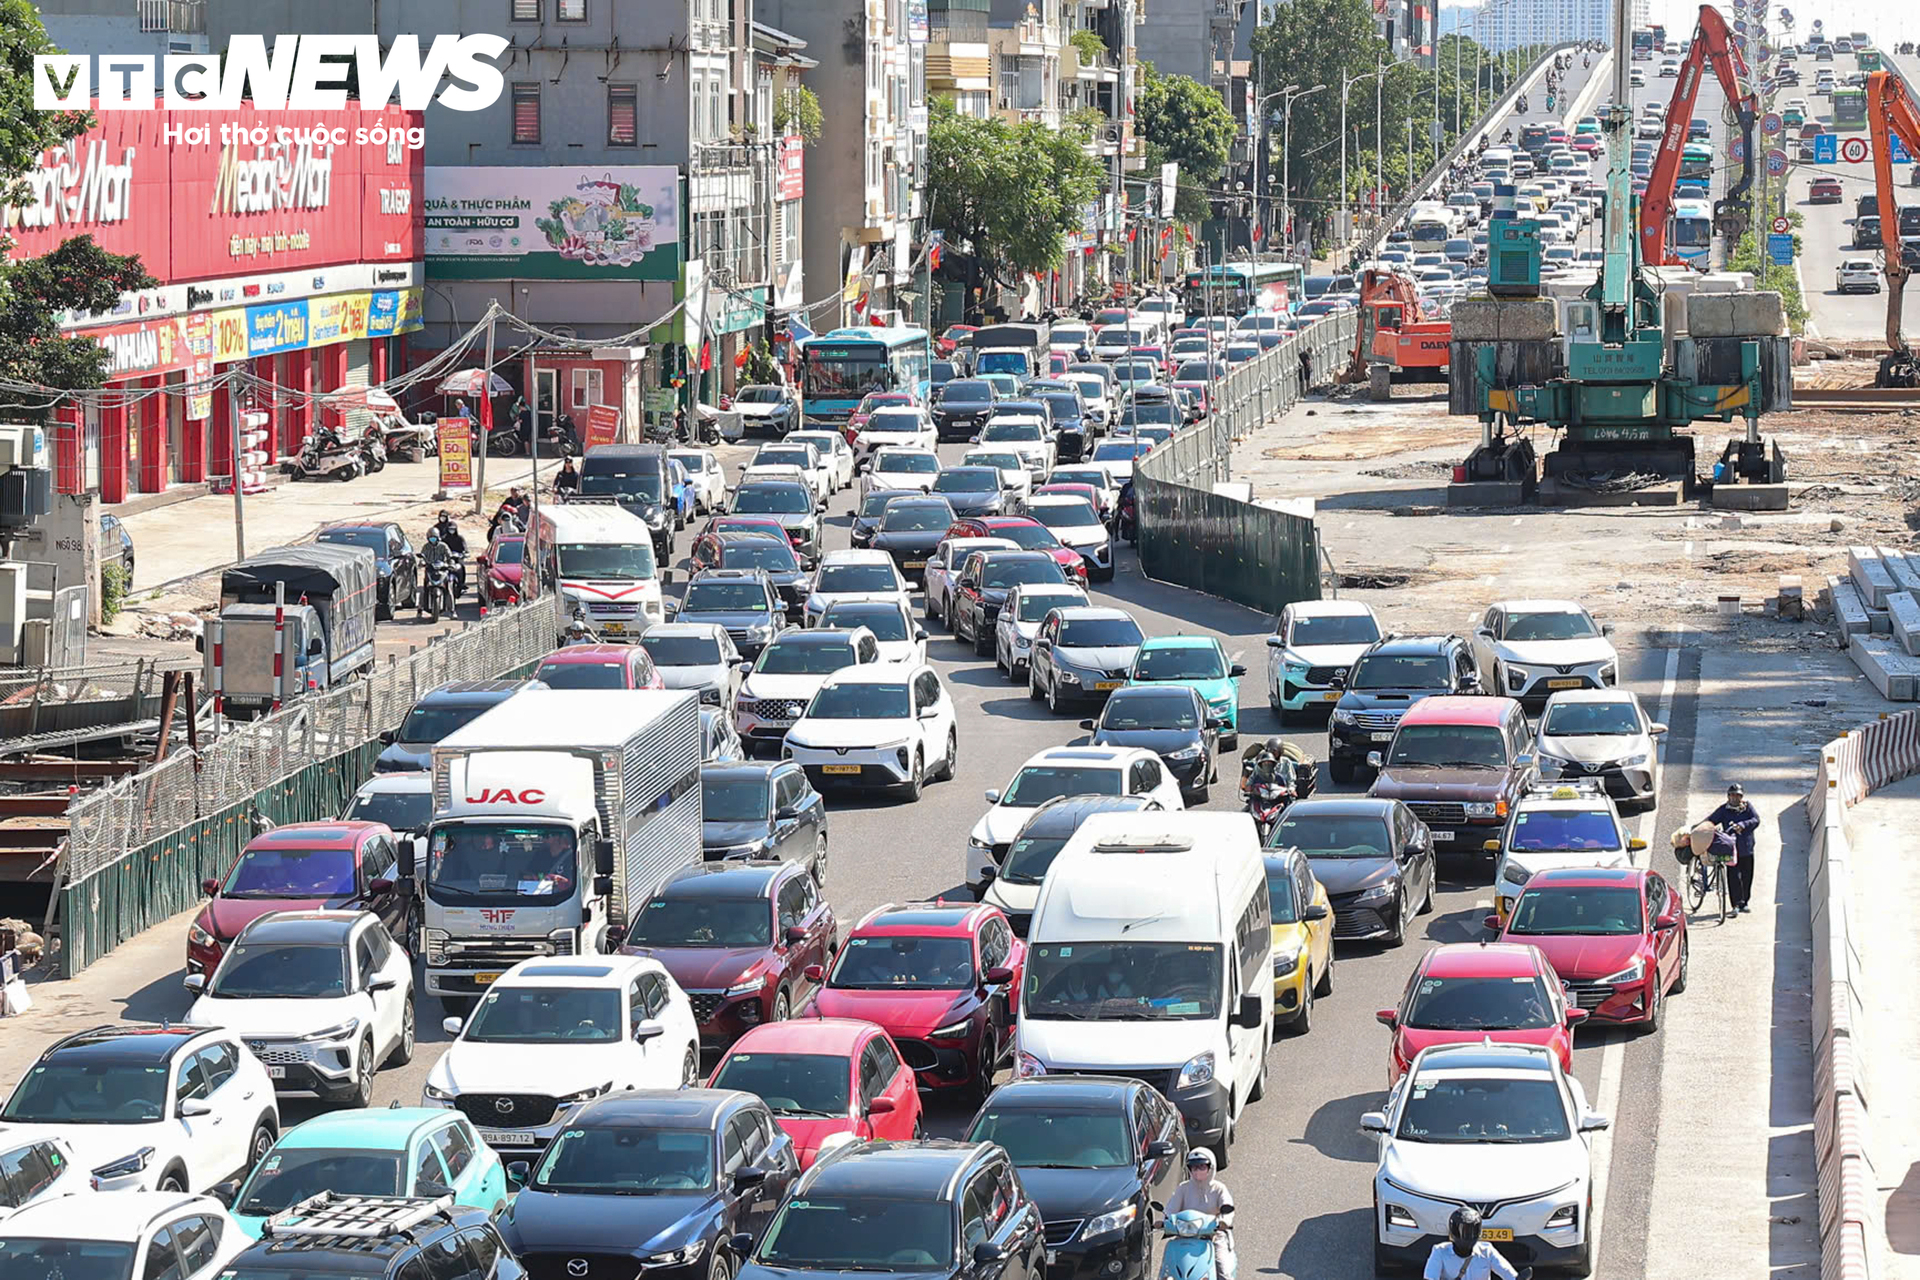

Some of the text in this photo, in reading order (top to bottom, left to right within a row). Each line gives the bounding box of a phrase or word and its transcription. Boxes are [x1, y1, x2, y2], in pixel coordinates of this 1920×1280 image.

[1681, 65, 1696, 99] DOOSAN
[1849, 144, 1860, 157] 60
[380, 182, 411, 214] TRẢ GÓP
[424, 195, 531, 213] QUẢ & THỰC PHẨM
[427, 218, 441, 227] AN
[443, 215, 470, 227] TOÀN
[477, 216, 498, 227] HỮU
[500, 217, 514, 227] CƠ
[275, 310, 284, 346] 2
[284, 307, 305, 345] triệu
[341, 301, 348, 335] 2
[350, 299, 365, 332] triệu
[116, 322, 159, 369] NHUẬN
[218, 319, 244, 355] 10%
[71, 540, 82, 551] 98
[466, 789, 545, 804] JAC
[480, 909, 516, 923] HT
